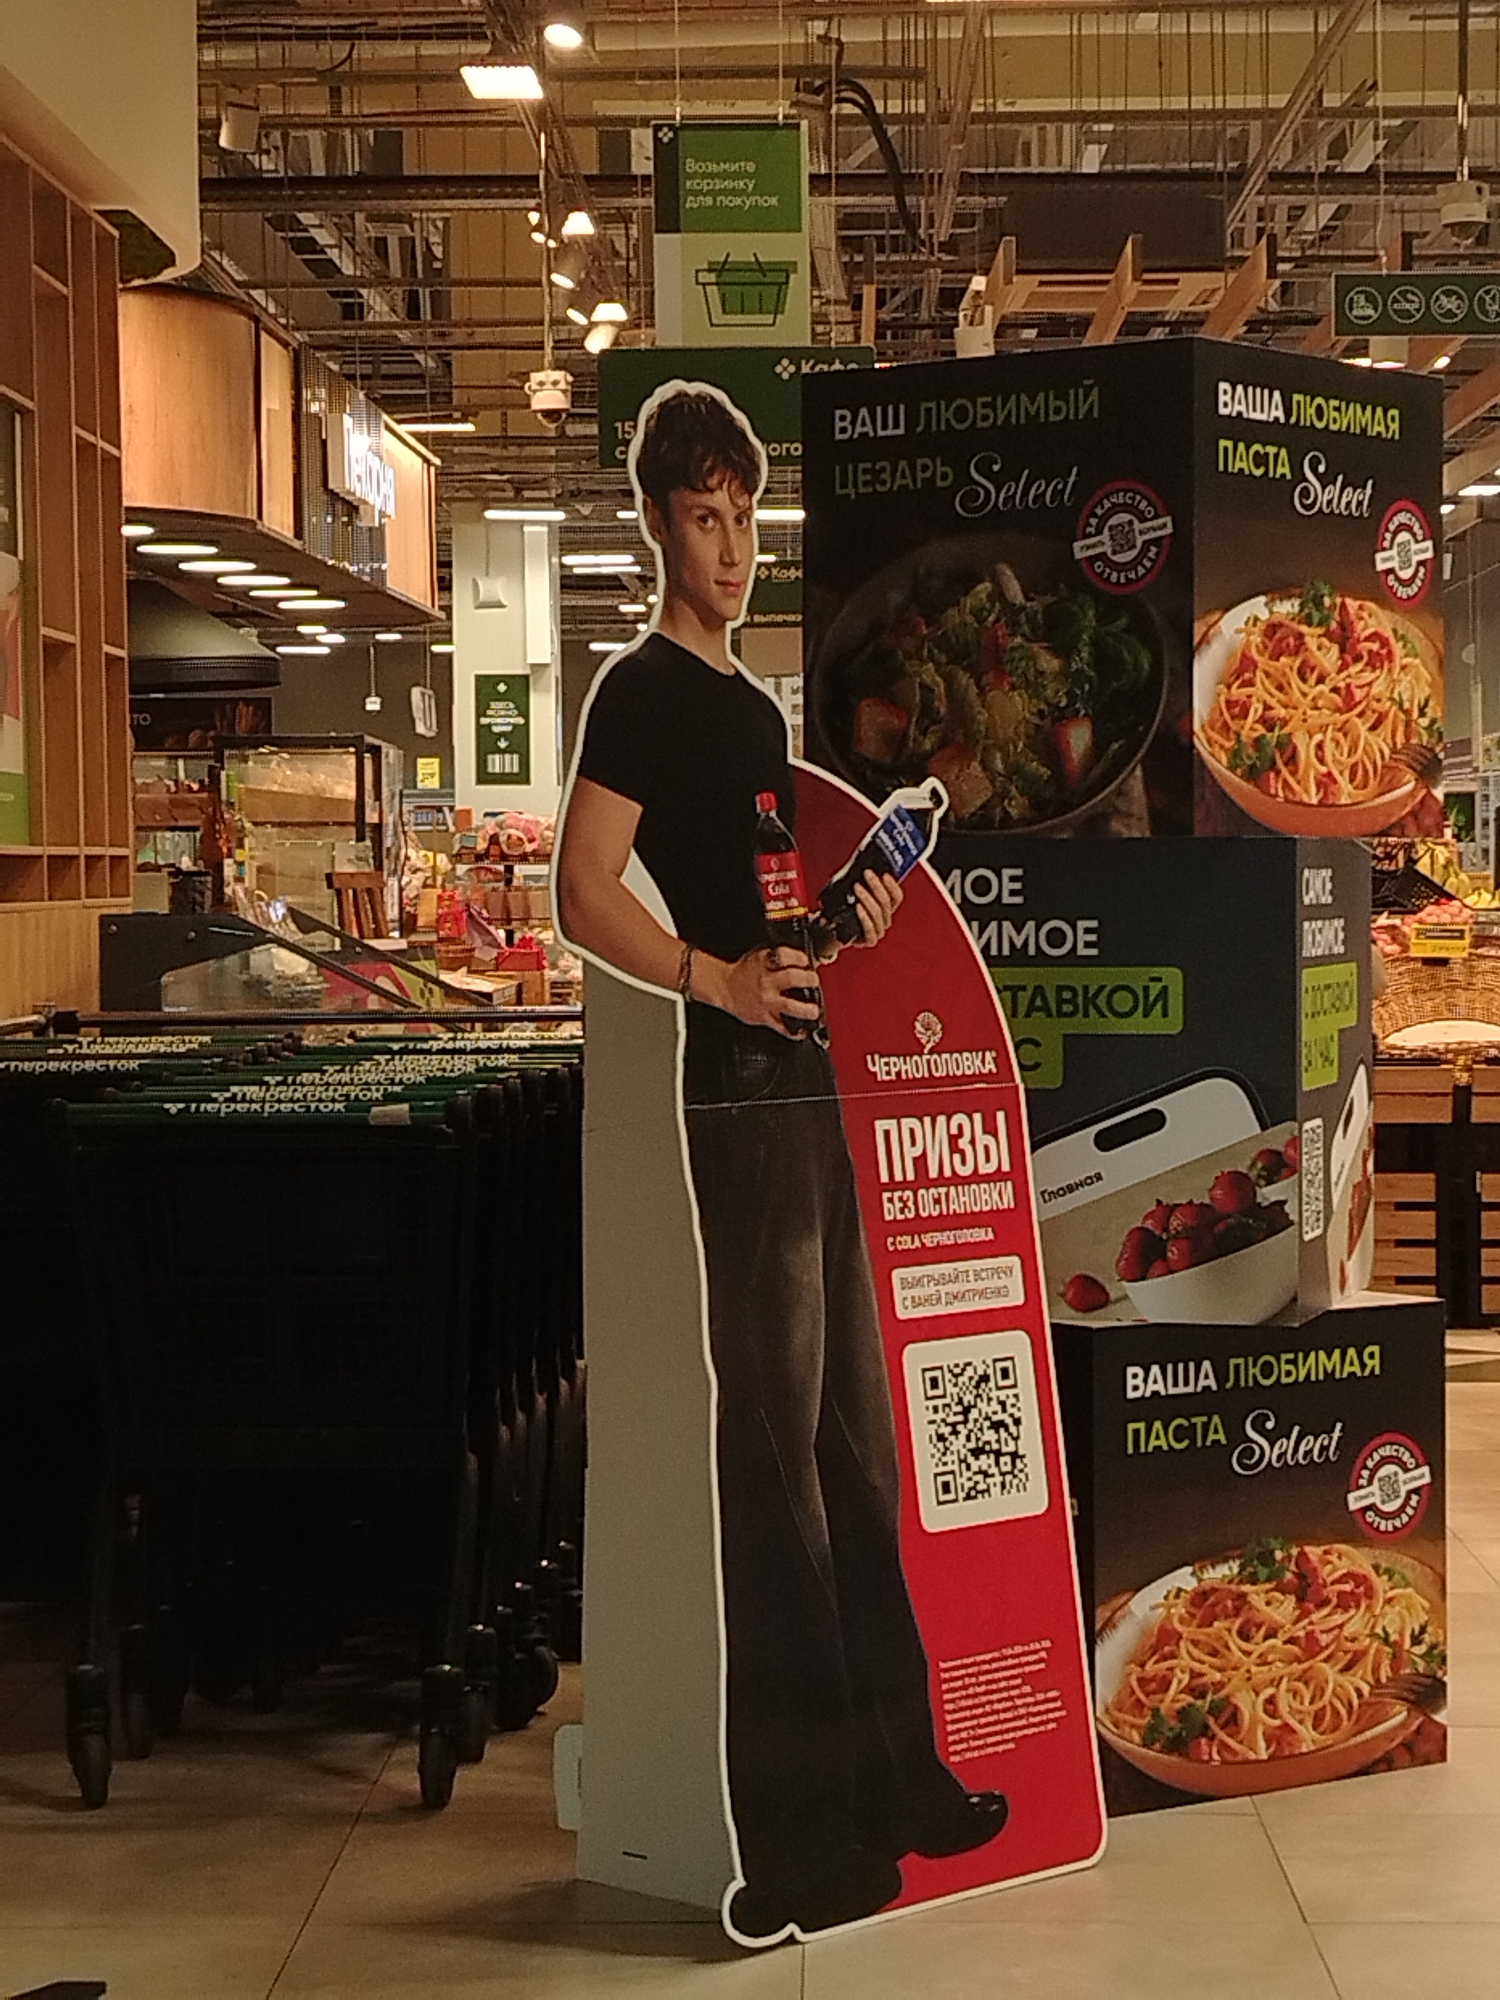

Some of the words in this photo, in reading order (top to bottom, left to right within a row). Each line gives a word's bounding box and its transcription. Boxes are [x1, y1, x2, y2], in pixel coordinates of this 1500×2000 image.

[685, 158, 756, 173] Возьмите
[685, 179, 756, 192] корзинку
[685, 196, 713, 209] для
[716, 196, 779, 210] покупок
[833, 404, 905, 440] ВАШ
[915, 378, 1099, 433] ЛЮБИМЫЙ
[1218, 381, 1285, 424] ВАША
[1290, 394, 1400, 440] ЛЮБИМАЯ
[834, 457, 954, 499] ЦЕЗАРЬ
[954, 451, 1079, 518] Select
[1218, 439, 1291, 480] ПАСТА
[1294, 451, 1374, 517] Select
[1094, 491, 1156, 519] КАЧЕСТВО
[1094, 545, 1160, 584] ОТВЕЧАЕМ
[995, 976, 1169, 1019] ТАВКОЙ
[867, 1050, 998, 1082] ЧЕРНОГОЛОВКА
[874, 1111, 1011, 1183] ПРИЗЫ
[882, 1190, 916, 1221] БЕЗ
[918, 1181, 1015, 1218] ОСТАНОВКИ
[1040, 1171, 1104, 1204] Главная
[900, 1266, 971, 1291] ВЫИГРЫВАЙТЕ
[973, 1265, 1014, 1282] ВСТРЕЧУ
[902, 1297, 909, 1310] С
[910, 1290, 942, 1309] ВАНЕЙ
[944, 1284, 1010, 1306] ДМИТРИЕНКО
[1126, 1360, 1218, 1400] ВАША
[1225, 1345, 1381, 1390] ЛЮБИМАЯ
[1127, 1414, 1227, 1454] ПАСТА
[1231, 1408, 1343, 1476] Select
[1366, 1444, 1416, 1469] КАЧЕСТВО
[1365, 1493, 1420, 1532] ОТВЕЧАЕМ
